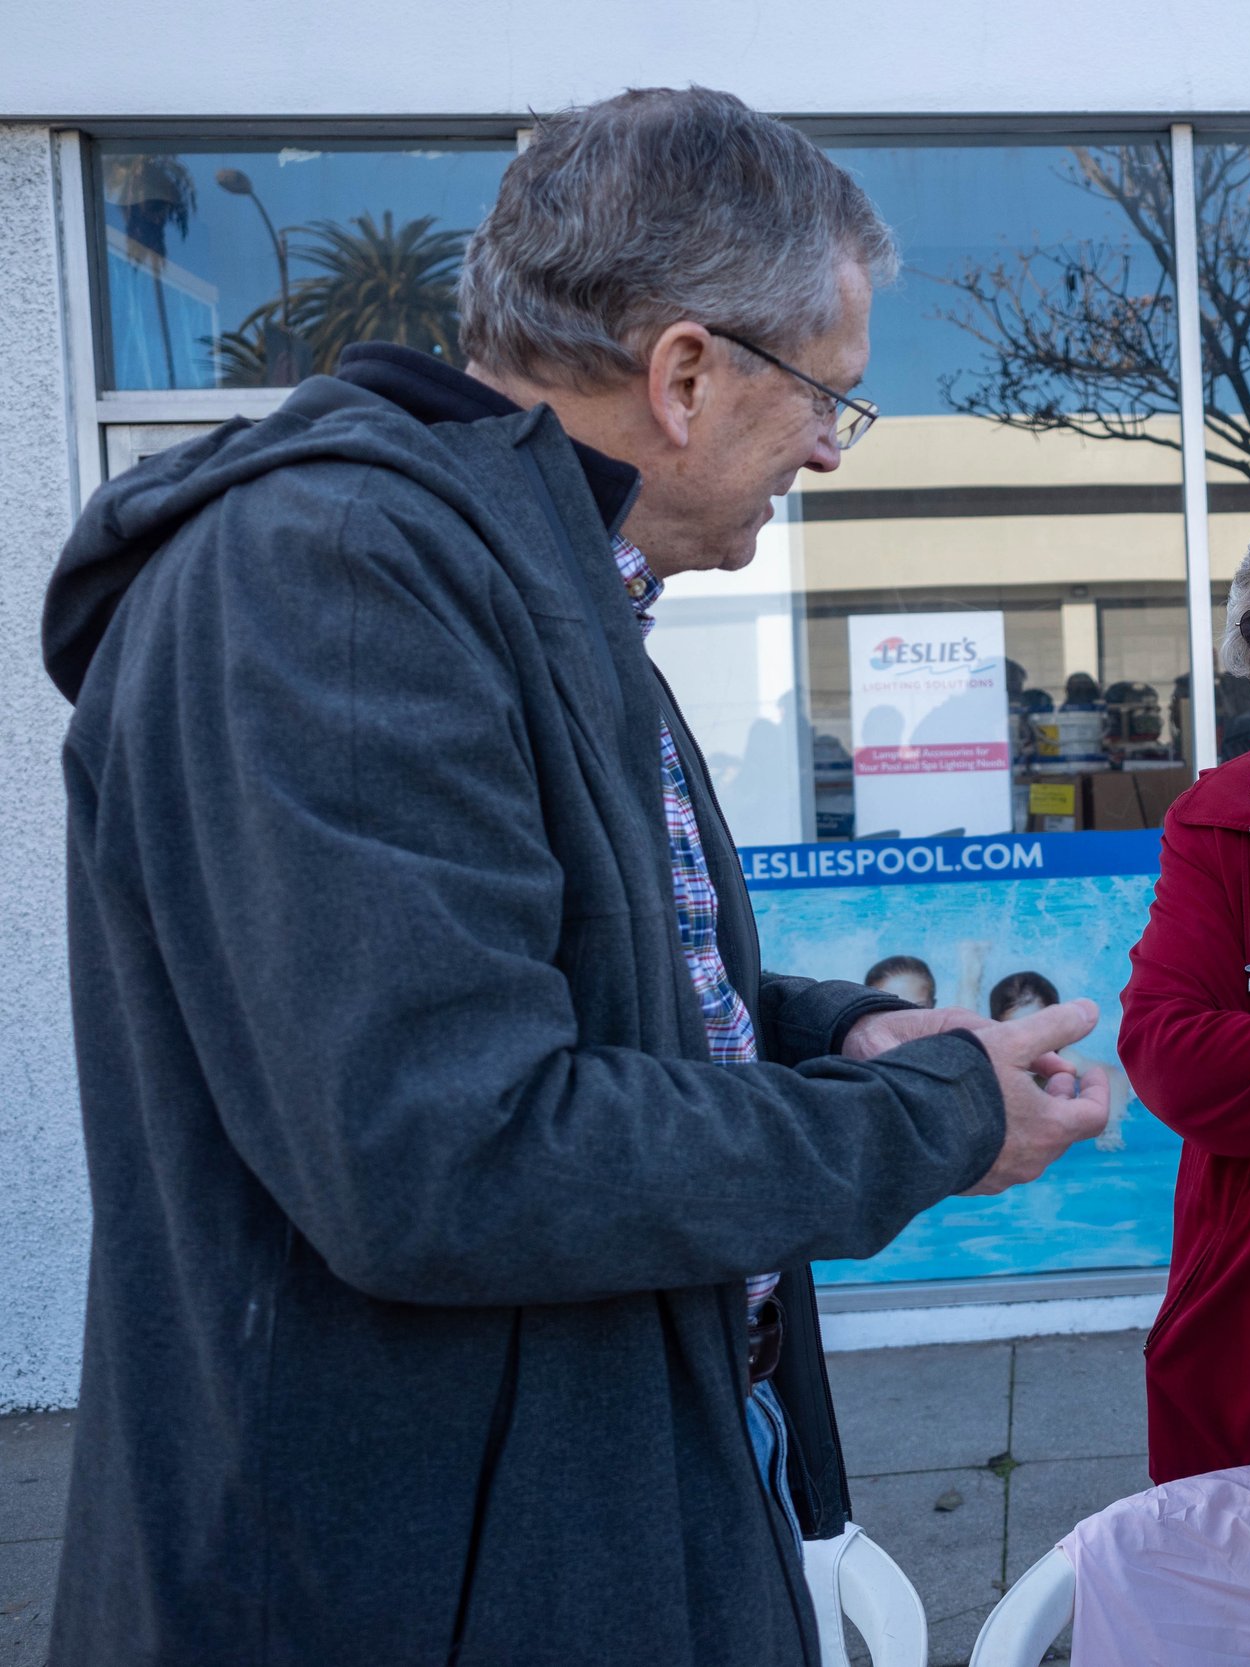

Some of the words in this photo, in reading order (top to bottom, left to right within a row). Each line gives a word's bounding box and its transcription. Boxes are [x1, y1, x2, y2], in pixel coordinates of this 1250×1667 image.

[881, 637, 978, 664] LESLIE'S
[863, 679, 921, 693] LIGHTING
[925, 677, 994, 690] SOLUTIONS
